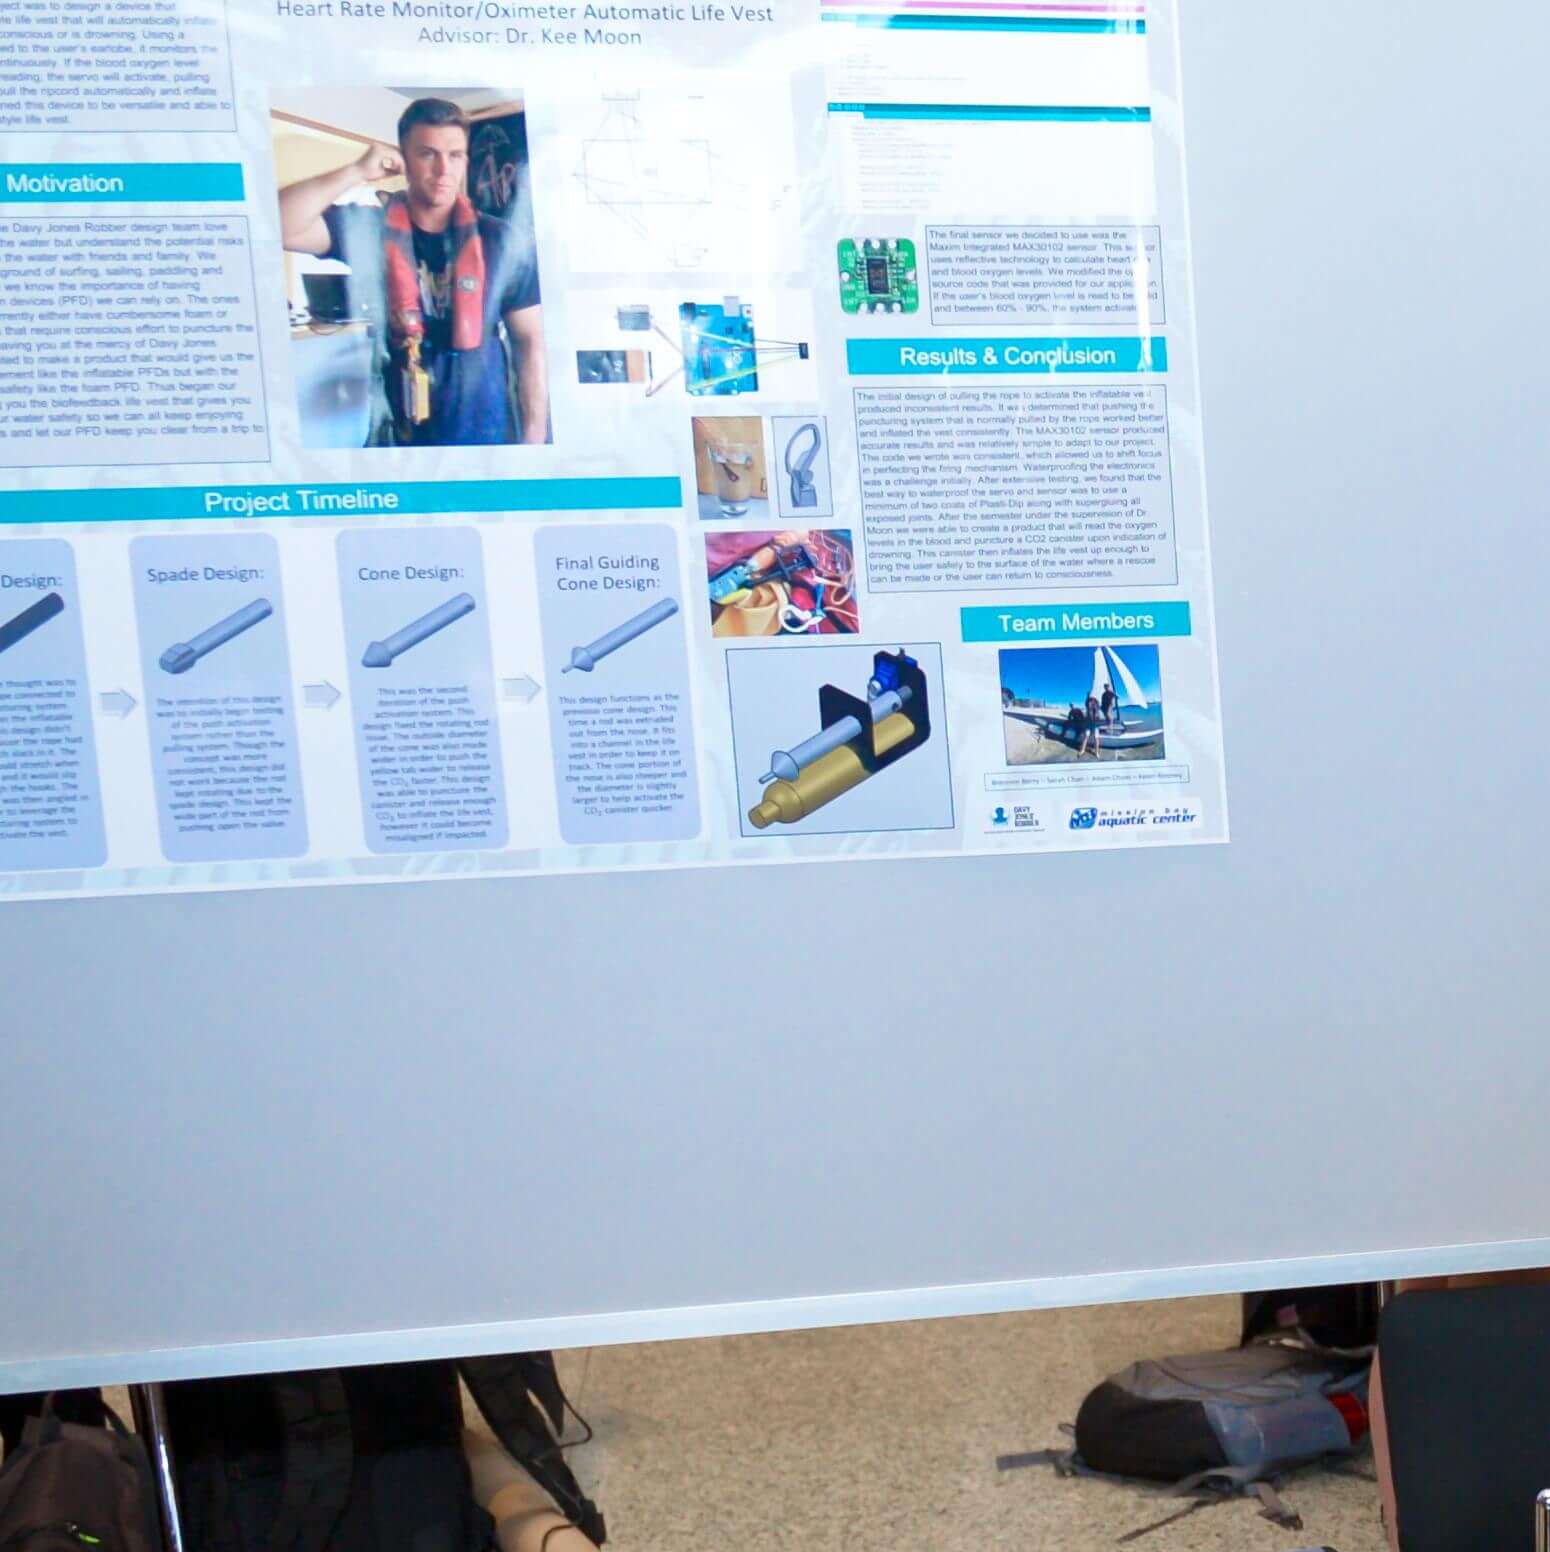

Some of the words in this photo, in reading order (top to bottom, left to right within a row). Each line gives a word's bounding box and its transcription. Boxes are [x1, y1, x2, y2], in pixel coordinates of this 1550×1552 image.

[276, 0, 332, 16] Heart
[340, 0, 385, 17] Rate
[392, 1, 575, 19] Monitor/Oximeter
[583, 4, 685, 20] Automatic
[691, 4, 724, 21] Life
[730, 5, 773, 22] Vest
[418, 26, 499, 43] Advisor:
[505, 27, 534, 44] Dr.
[540, 28, 576, 44] Kee
[583, 28, 641, 45] Moon
[6, 174, 123, 192] Motivation
[900, 347, 977, 367] Results
[982, 346, 997, 365] &
[1004, 345, 1115, 366] Conclusion
[204, 492, 290, 514] Project
[296, 489, 398, 509] Timeline
[555, 556, 593, 570] Final
[597, 555, 660, 571] Guiding
[0, 574, 62, 590] Design:
[146, 567, 199, 583] Spade
[203, 566, 264, 582] Design:
[358, 567, 400, 581] Cone
[404, 566, 464, 581] Design:
[556, 577, 598, 591] Cone
[602, 576, 660, 591] Design:
[1000, 614, 1055, 632] Team
[1062, 612, 1154, 630] Members
[1098, 816, 1147, 828] aquatic
[1152, 814, 1197, 824] center
